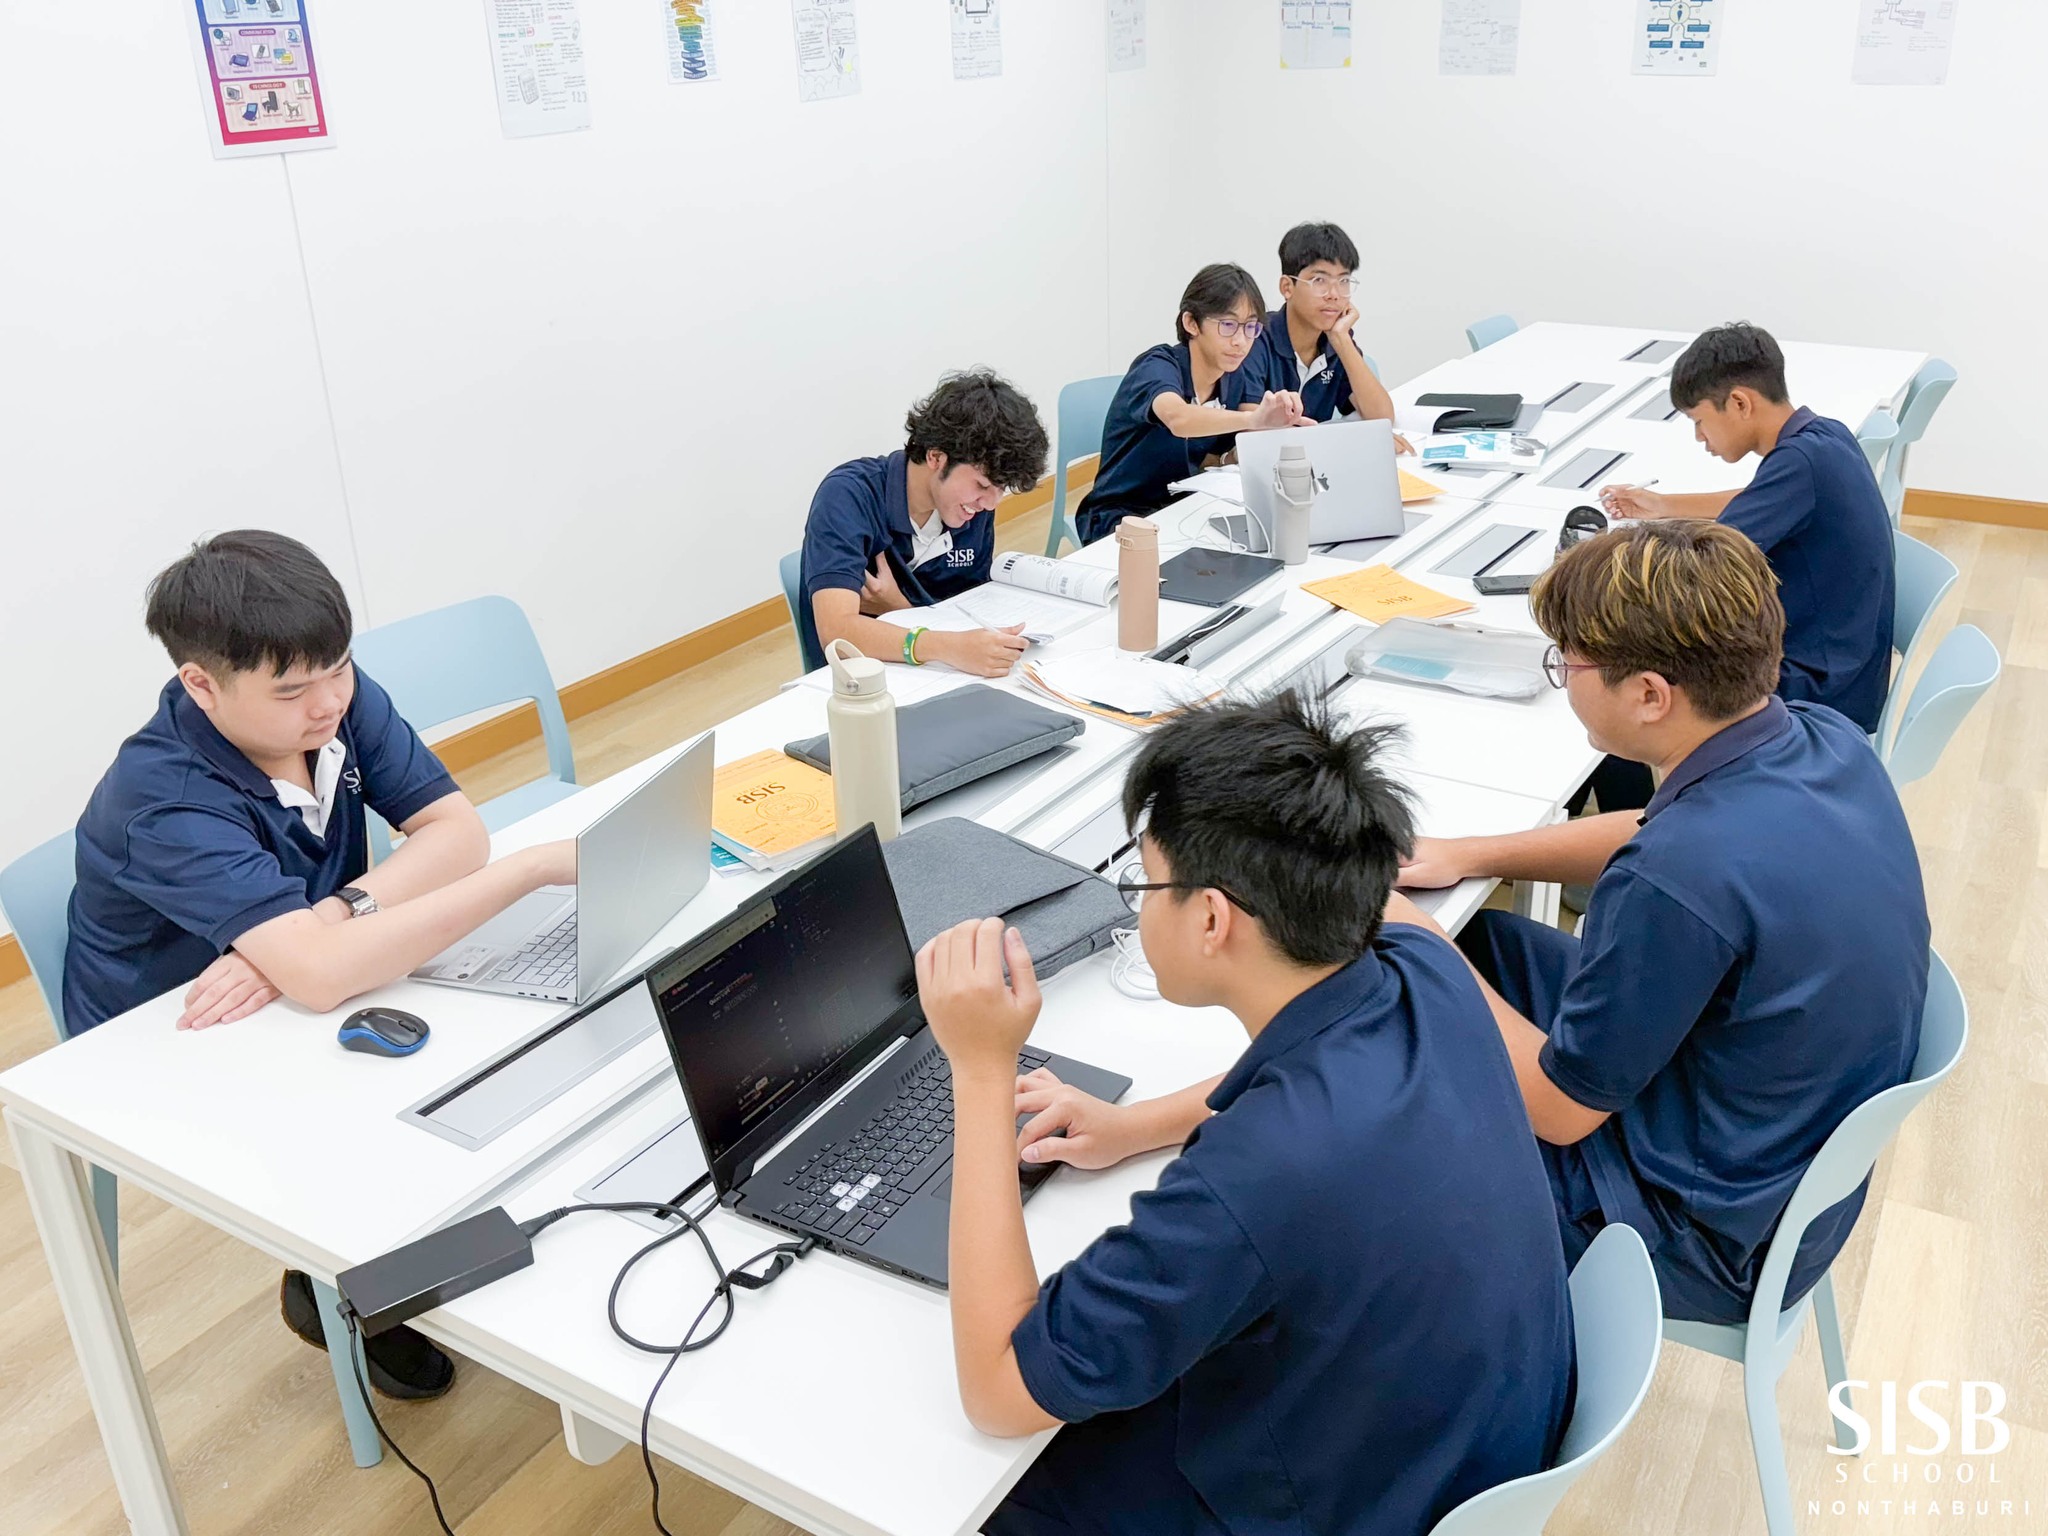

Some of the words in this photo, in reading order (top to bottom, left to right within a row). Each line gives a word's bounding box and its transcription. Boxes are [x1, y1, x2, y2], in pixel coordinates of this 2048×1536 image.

[251, 82, 283, 90] TECHNOLOGY
[946, 548, 975, 563] SISB
[736, 781, 786, 805] SISB
